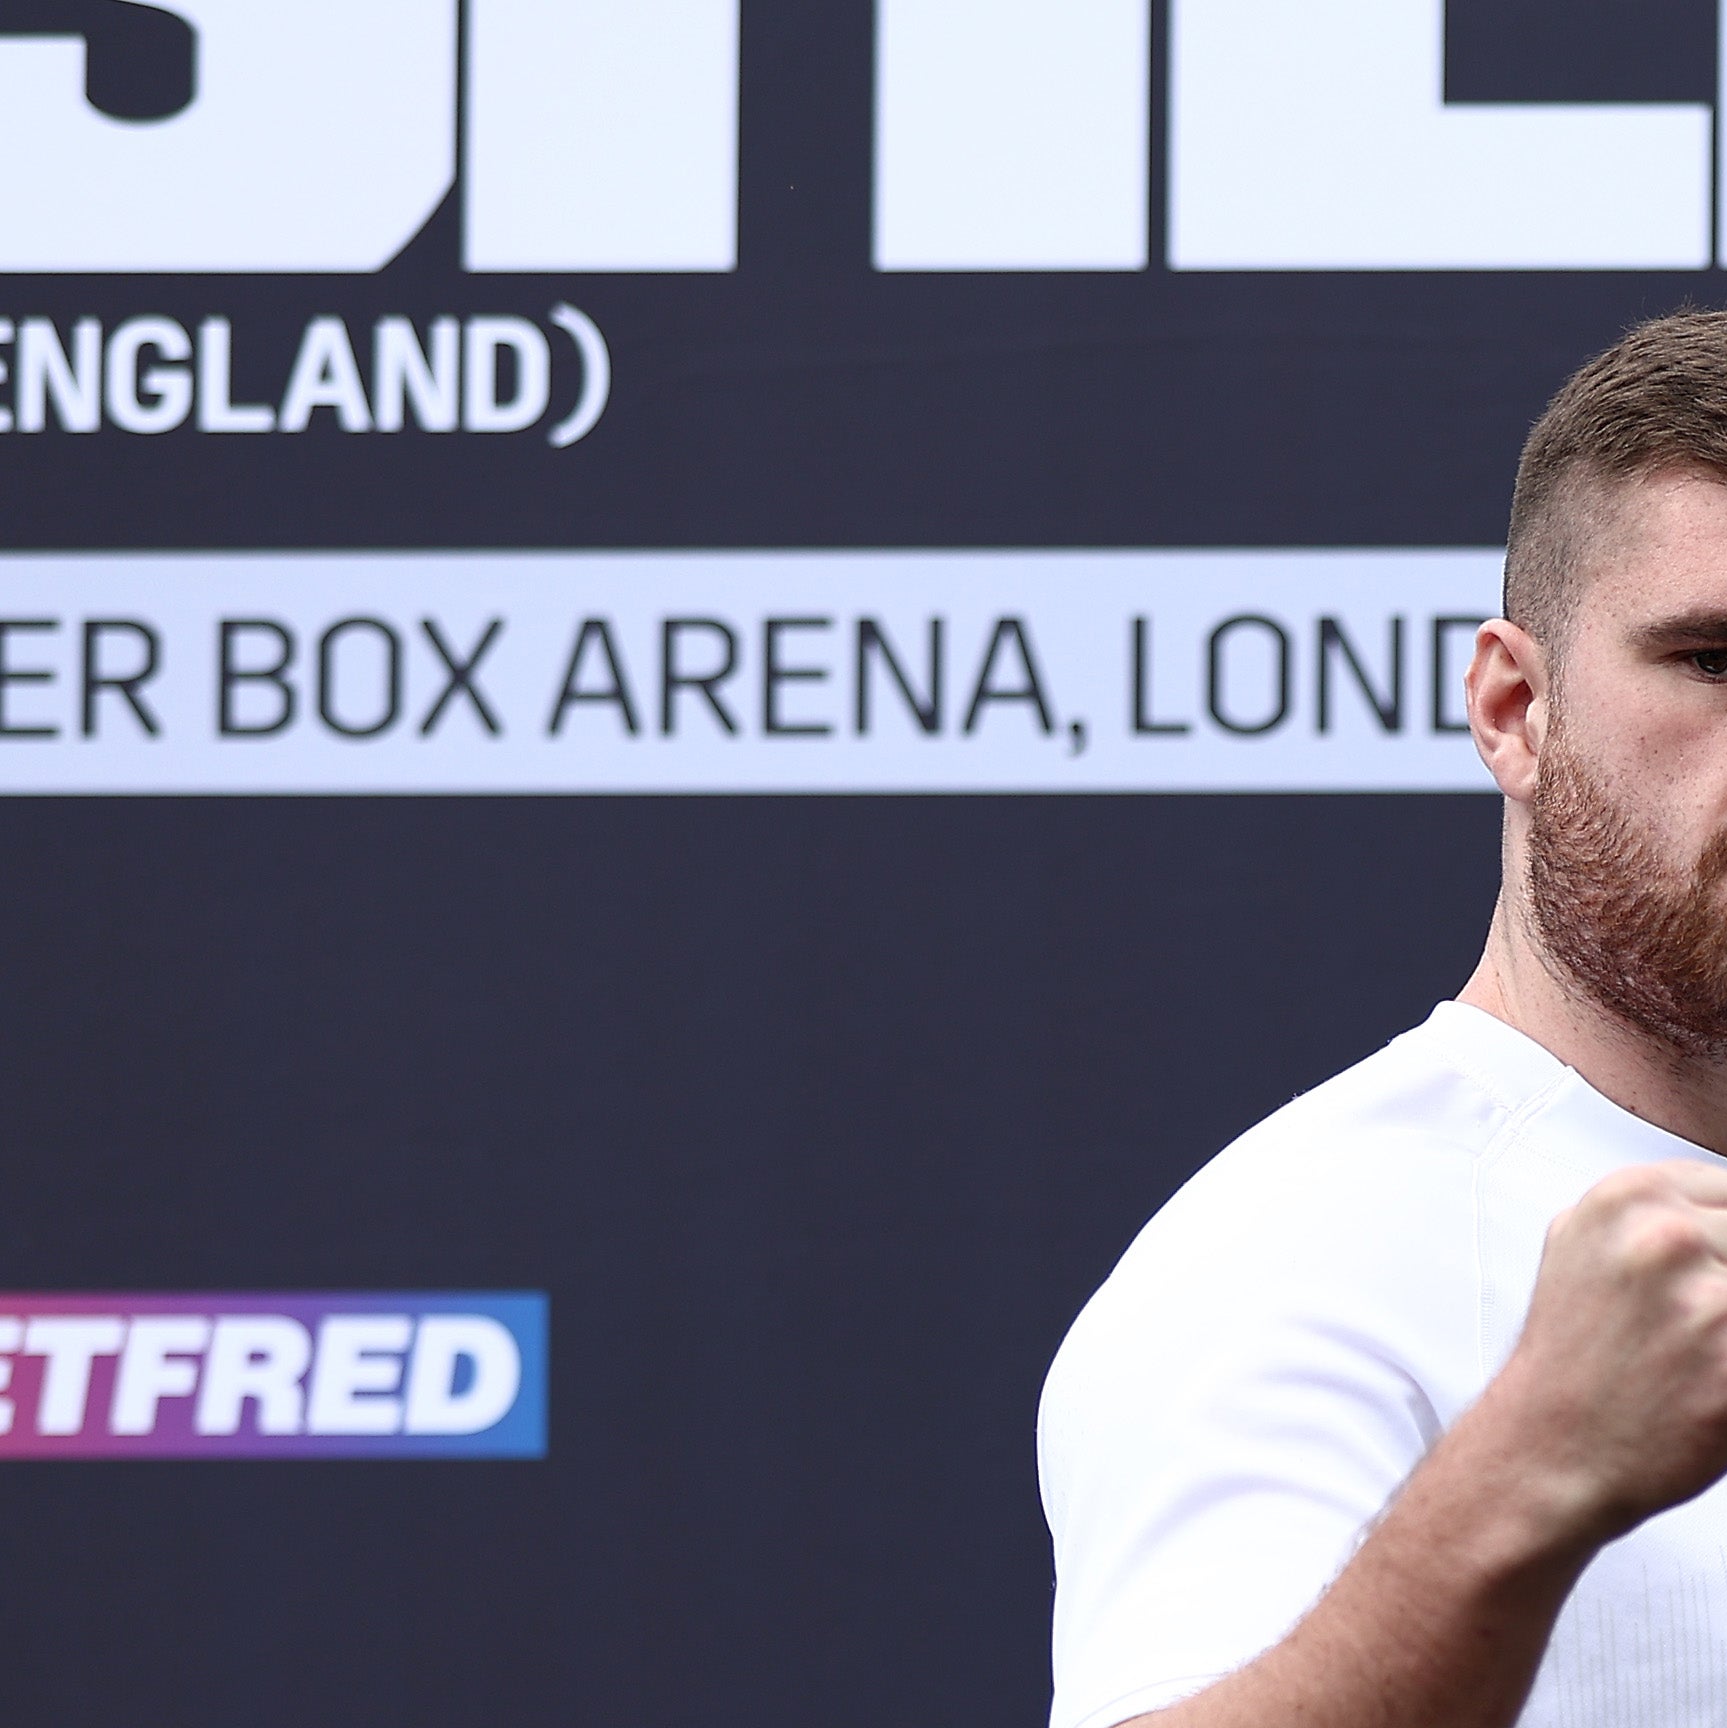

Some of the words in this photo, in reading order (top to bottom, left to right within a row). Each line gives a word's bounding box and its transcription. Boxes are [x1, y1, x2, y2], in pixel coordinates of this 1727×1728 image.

[0, 304, 611, 448] NGLAND)
[214, 610, 503, 735] BOX
[546, 611, 1087, 755] ARENA,
[0, 1315, 521, 1436] TFRED
